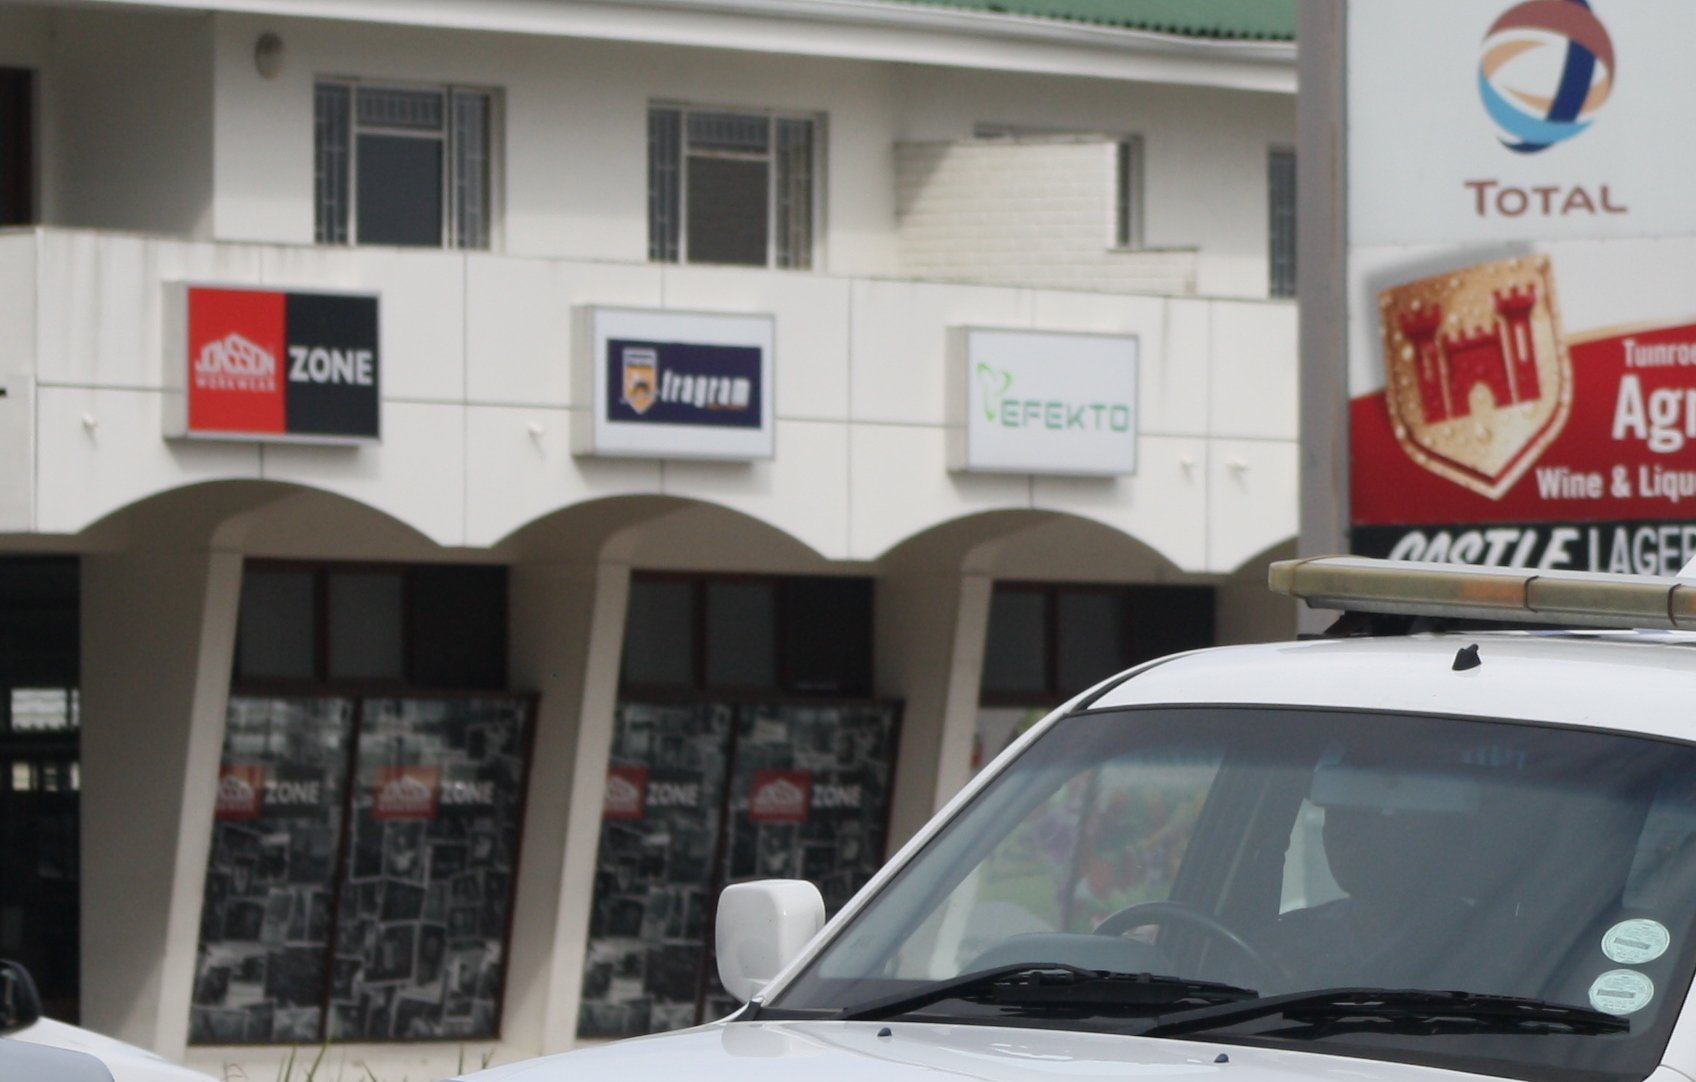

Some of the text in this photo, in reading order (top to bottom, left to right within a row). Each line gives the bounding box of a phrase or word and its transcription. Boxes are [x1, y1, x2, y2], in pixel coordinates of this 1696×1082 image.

[289, 347, 373, 385] ZONE
[1001, 399, 1130, 432] EFEKTO
[1536, 466, 1602, 499] Wine
[1611, 466, 1631, 498] &
[264, 779, 319, 804] ZONE
[440, 779, 494, 804] ZONE
[646, 783, 699, 806] ZONE
[811, 783, 863, 807] ZONE
